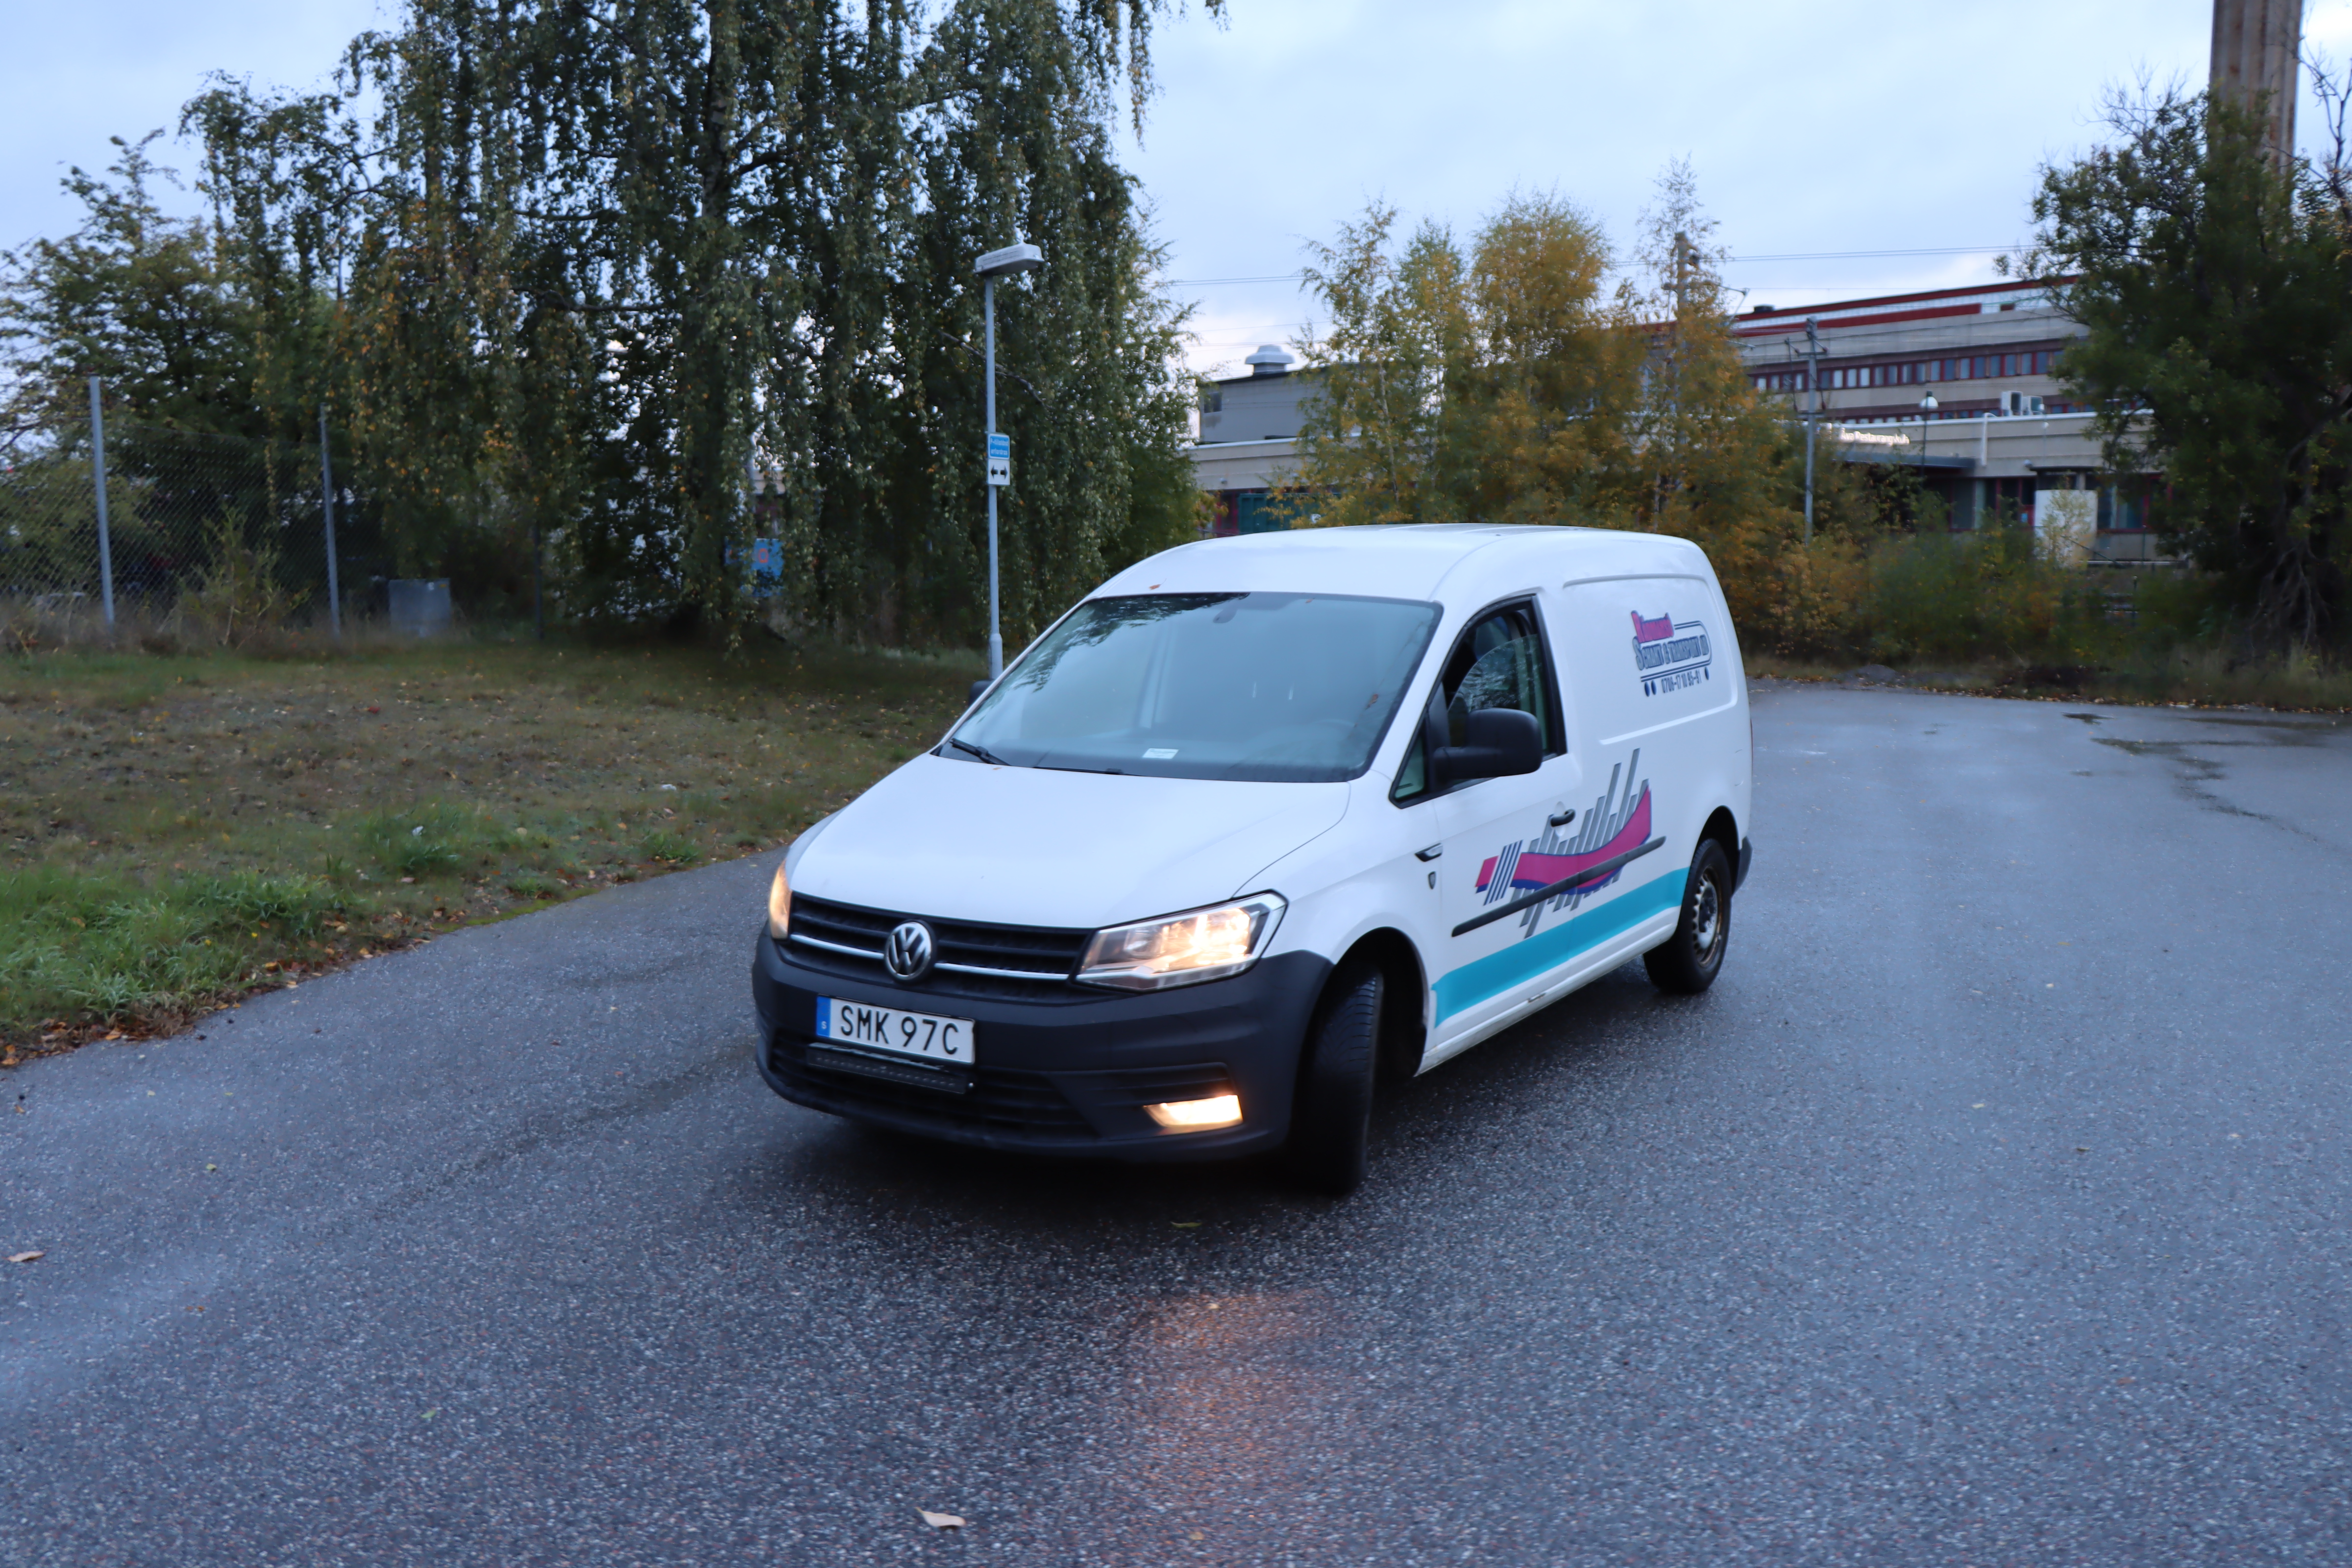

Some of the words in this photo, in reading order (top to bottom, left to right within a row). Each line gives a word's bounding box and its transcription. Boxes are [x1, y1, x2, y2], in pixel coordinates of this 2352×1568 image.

[821, 1021, 827, 1029] S
[841, 1005, 890, 1044] SMK
[901, 1016, 959, 1055] 97C
